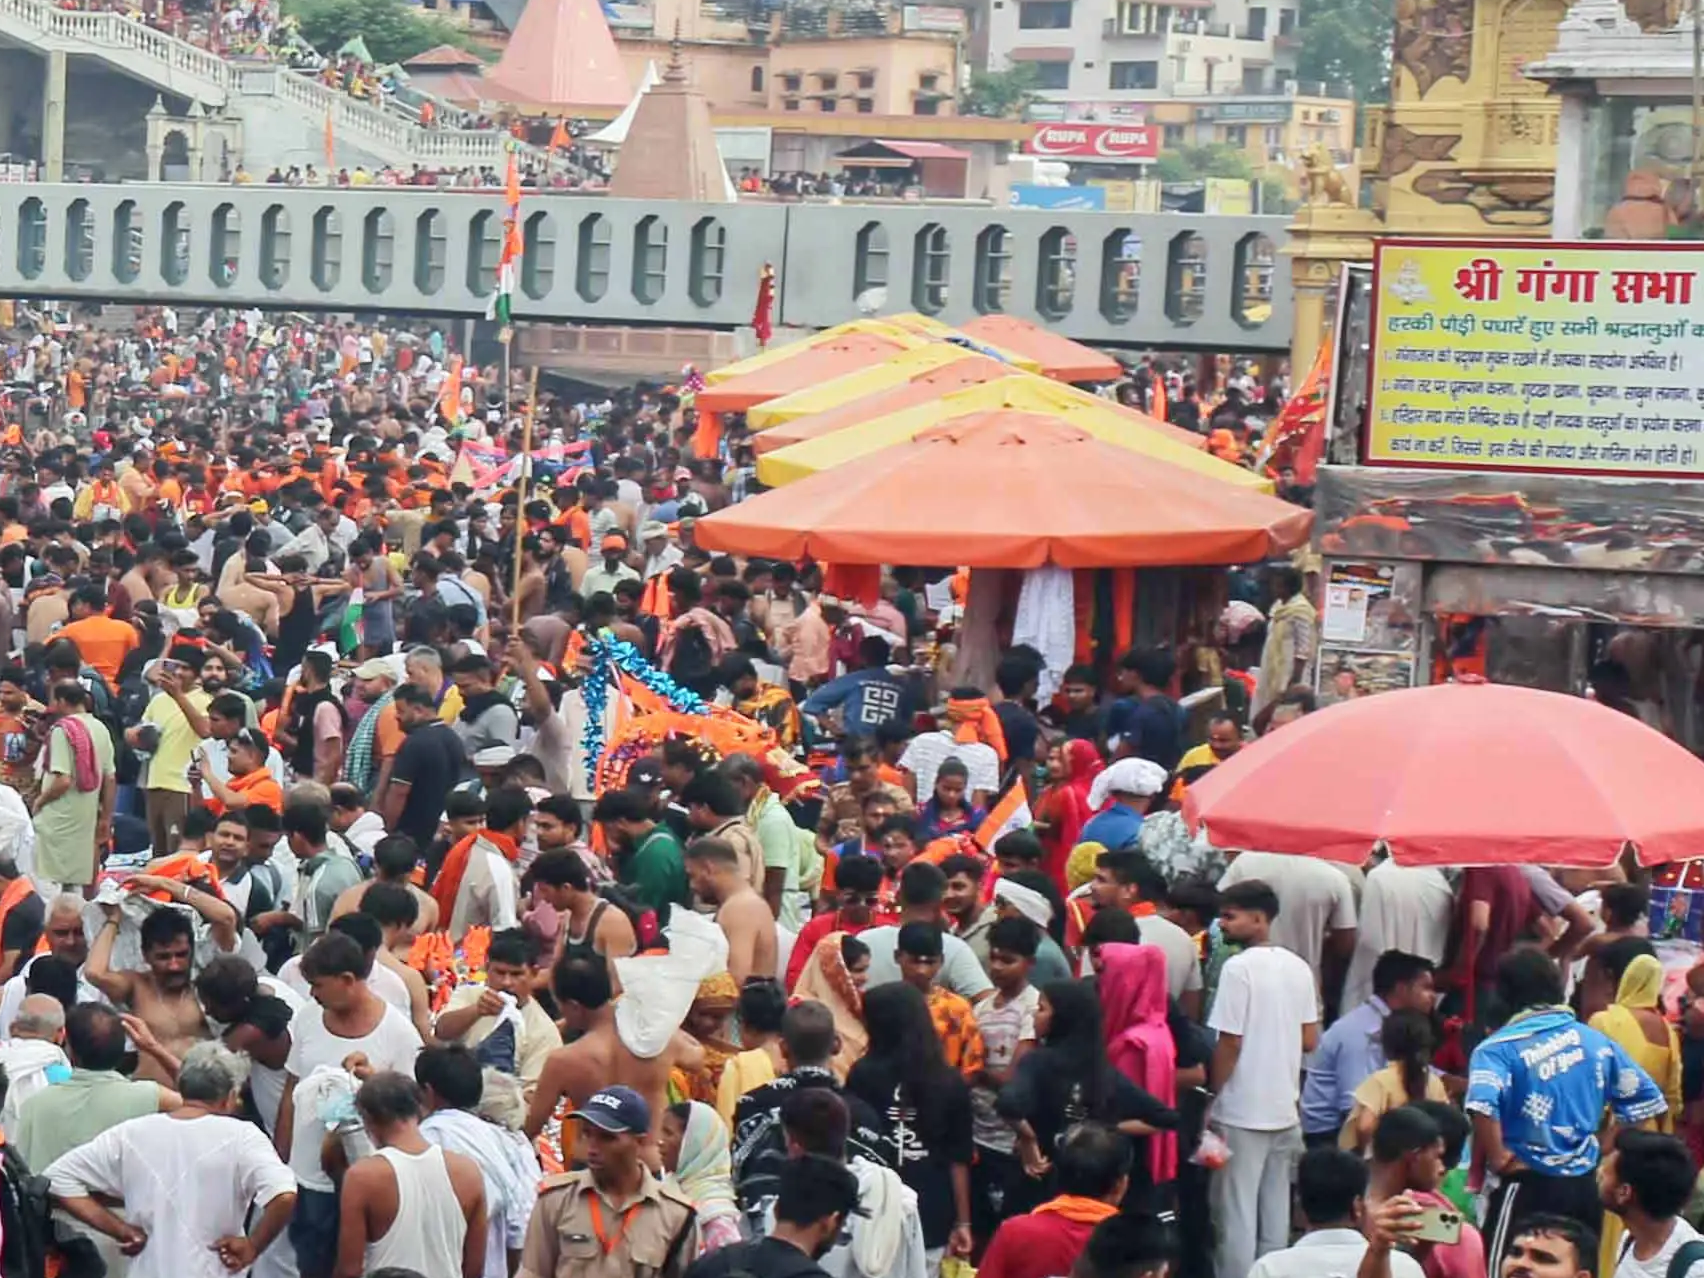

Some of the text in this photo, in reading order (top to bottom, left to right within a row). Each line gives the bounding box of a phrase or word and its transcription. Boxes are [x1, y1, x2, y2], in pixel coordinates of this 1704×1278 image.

[1454, 258, 1697, 305] श्री गंगा सभा
[1561, 315, 1598, 336] सभी
[1519, 1027, 1582, 1066] Thinking
